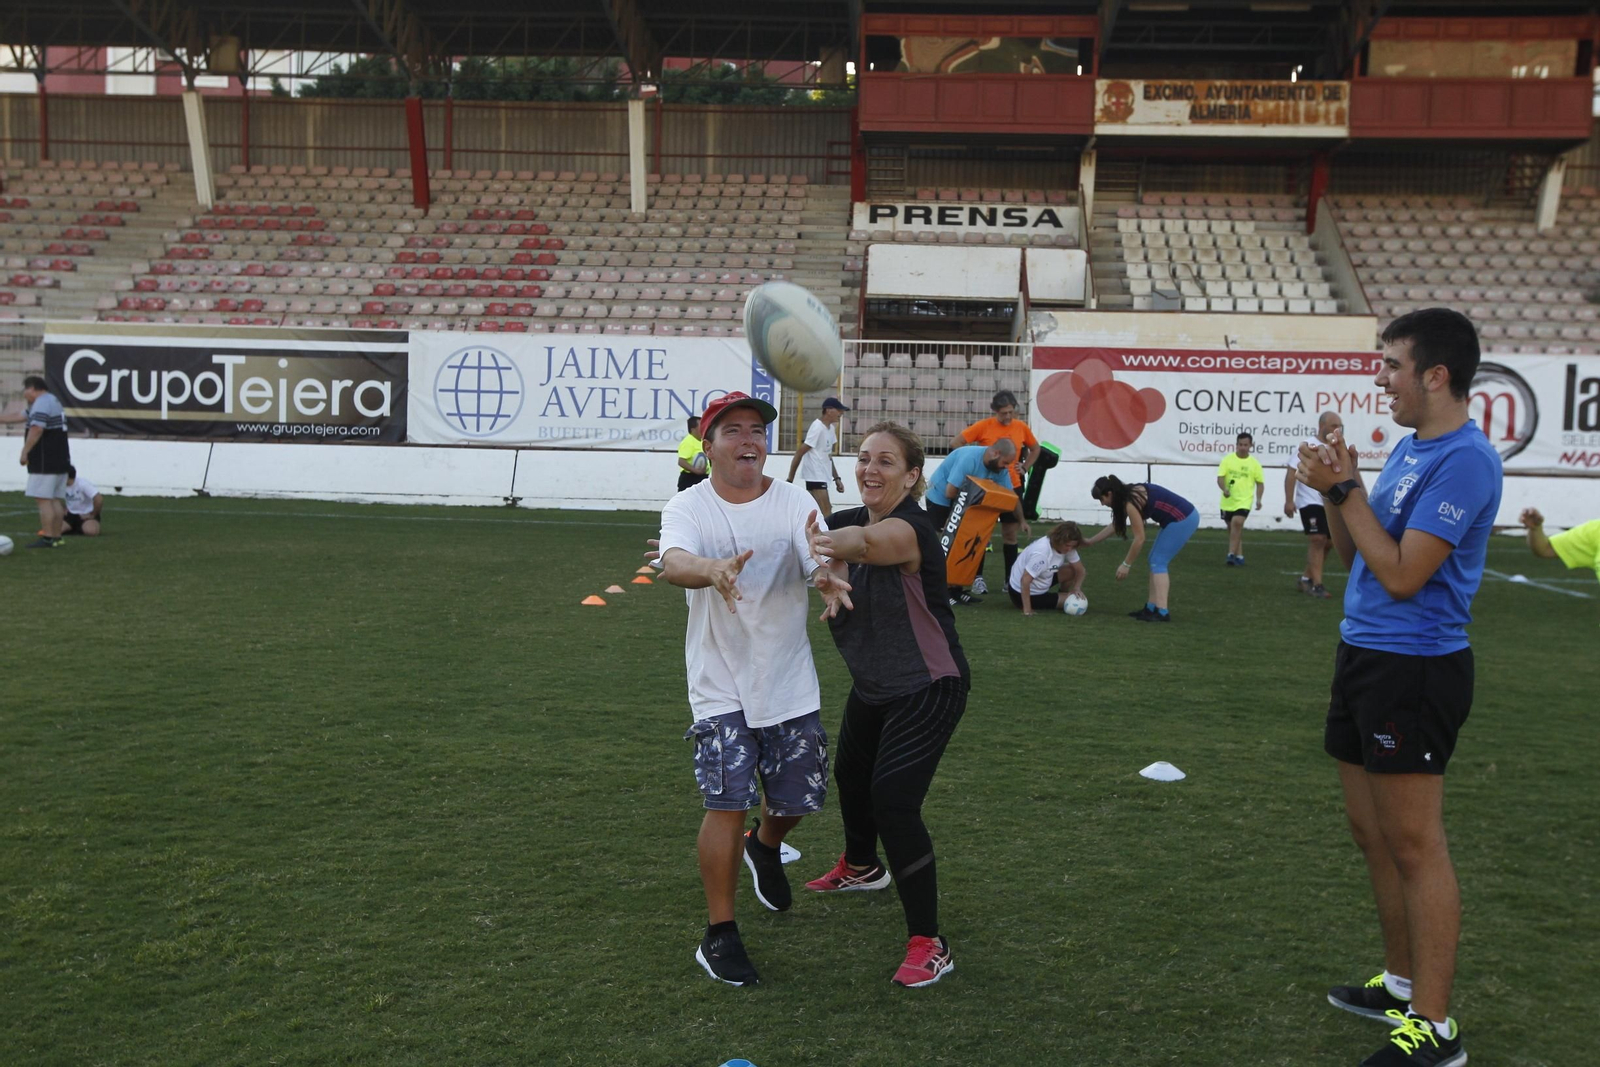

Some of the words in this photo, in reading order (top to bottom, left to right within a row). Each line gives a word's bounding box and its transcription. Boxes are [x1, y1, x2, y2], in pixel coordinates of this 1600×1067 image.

[1143, 85, 1198, 101] EXCMO.
[1206, 85, 1316, 101] AYUNTAMIENTO
[1322, 85, 1341, 101] DE
[1189, 104, 1251, 120] ALMERIA
[868, 204, 1064, 229] PRENSA
[539, 346, 670, 386] JAIME
[1175, 389, 1305, 413] CONECTA
[1315, 391, 1390, 415] PYME
[236, 421, 381, 437] www.grupotejera.com
[538, 426, 604, 441] BUFETE
[608, 428, 626, 441] DE
[1179, 421, 1258, 437] Distribuidor
[1178, 439, 1235, 453] Vodafon
[947, 491, 968, 532] webb
[1438, 501, 1464, 521] BNI
